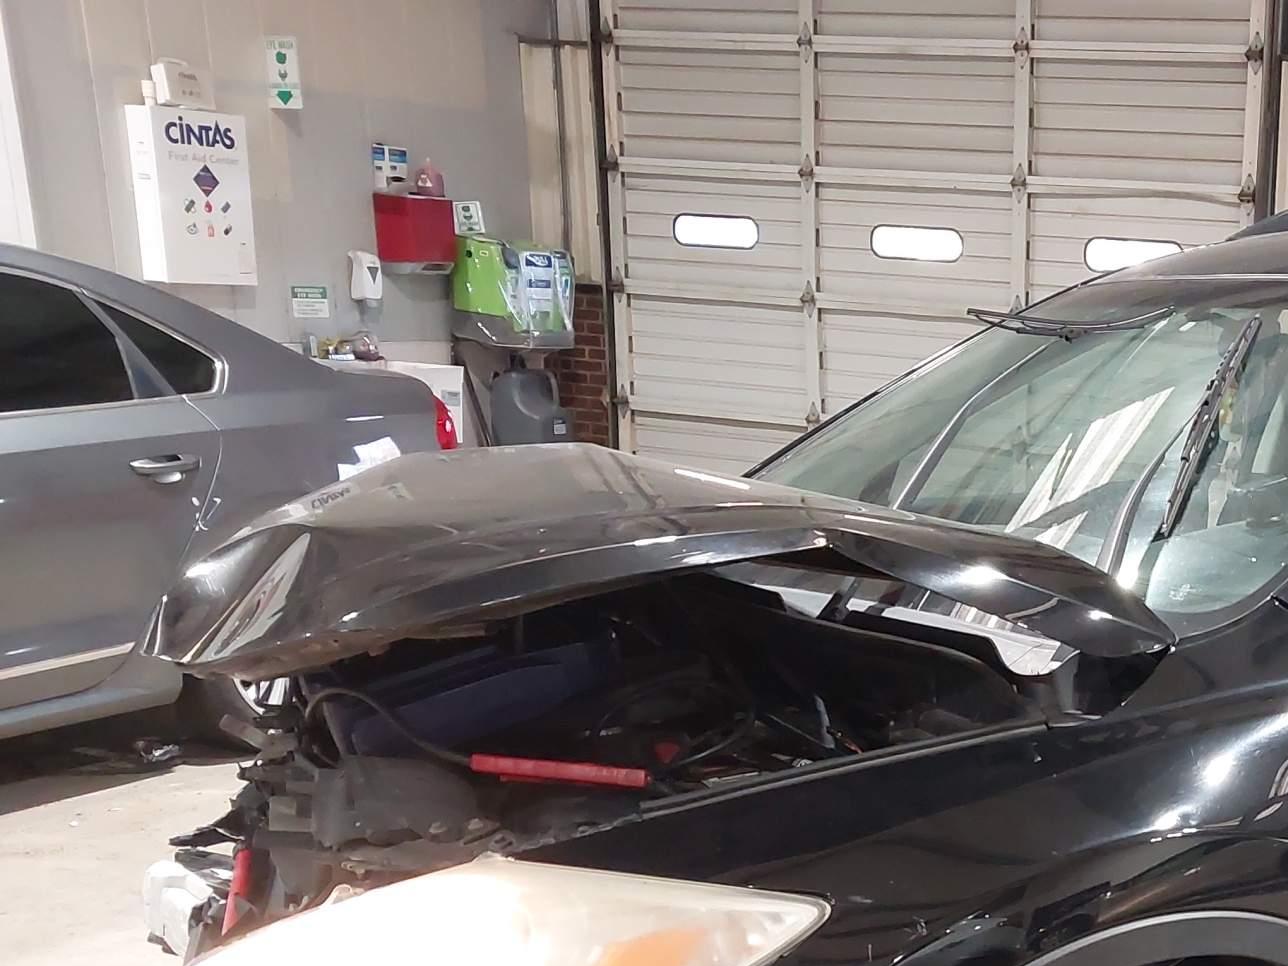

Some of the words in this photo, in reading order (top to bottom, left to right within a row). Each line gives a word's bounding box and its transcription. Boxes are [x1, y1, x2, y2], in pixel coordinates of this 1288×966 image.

[168, 150, 189, 161] First
[192, 151, 207, 162] Aid
[209, 154, 240, 165] Center
